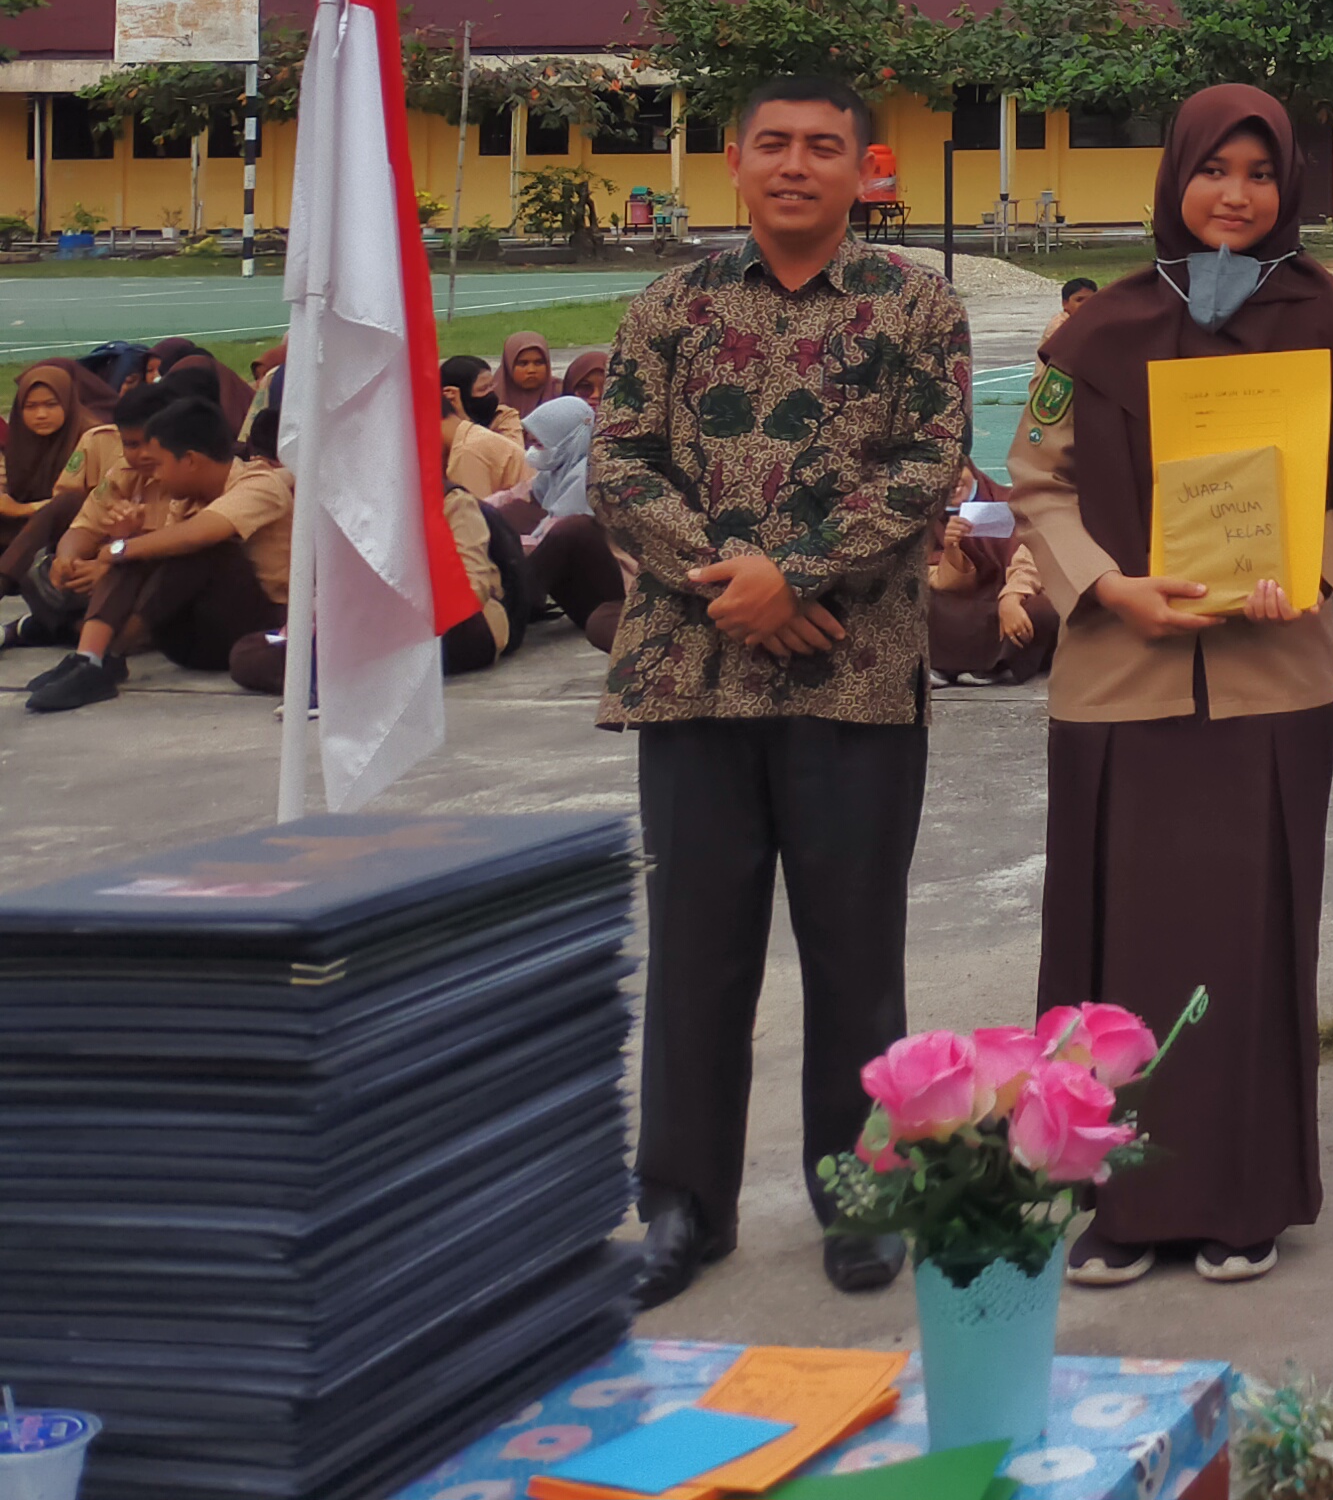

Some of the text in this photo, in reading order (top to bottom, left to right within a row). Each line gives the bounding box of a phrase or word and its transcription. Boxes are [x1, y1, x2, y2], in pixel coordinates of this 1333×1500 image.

[1178, 481, 1233, 504] JUARA
[1210, 501, 1263, 519] UMUM
[1224, 523, 1273, 544] KELAS
[1233, 553, 1254, 576] XII
